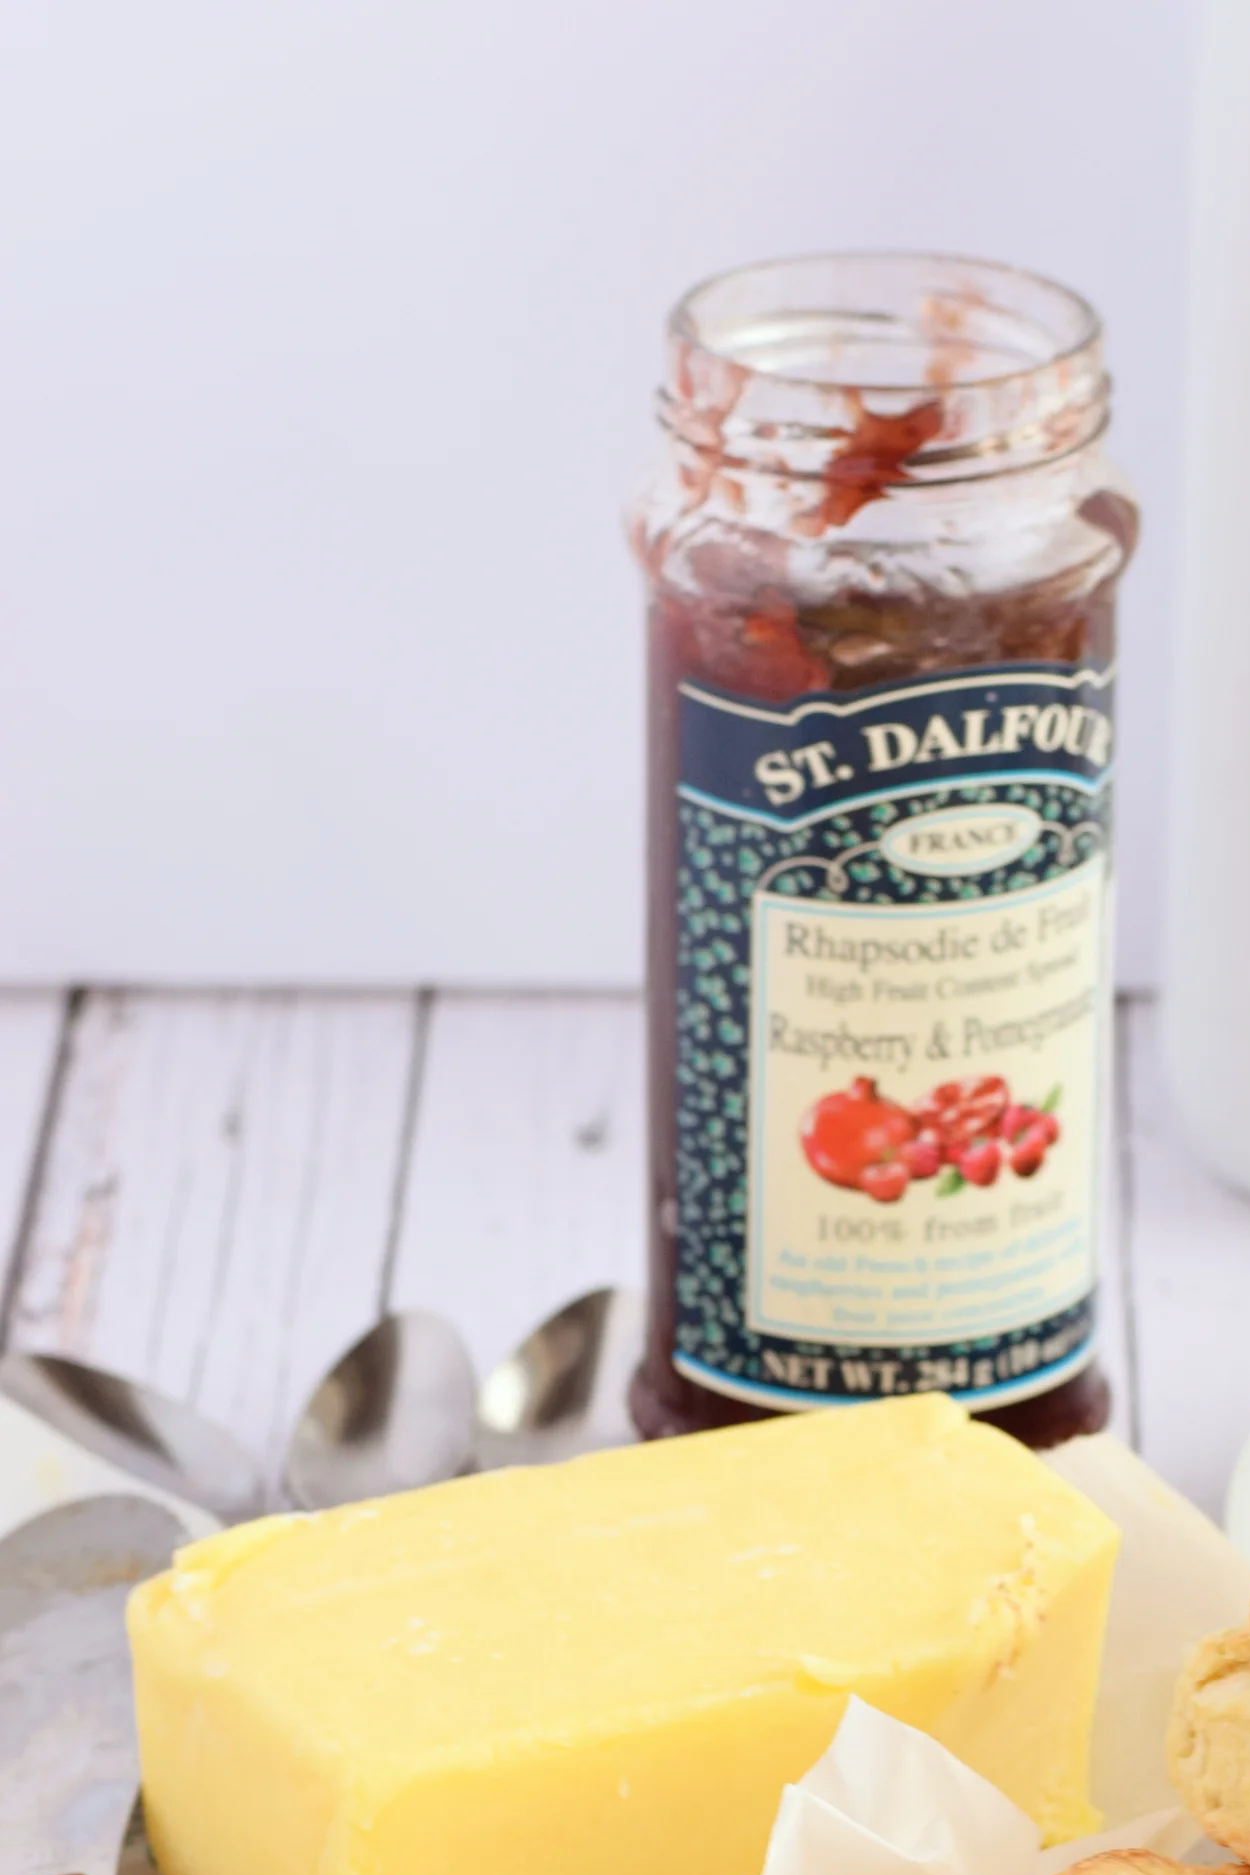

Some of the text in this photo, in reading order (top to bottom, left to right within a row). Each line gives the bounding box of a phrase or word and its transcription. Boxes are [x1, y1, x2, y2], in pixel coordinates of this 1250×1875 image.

[754, 741, 854, 806] ST.
[908, 822, 1019, 856] FRANCE
[784, 920, 980, 972] Rhapsodie
[990, 917, 1028, 954] de
[768, 1011, 916, 1073] Raspberry
[924, 1020, 952, 1061] &
[816, 1213, 909, 1244] 100%
[922, 1212, 999, 1244] from
[762, 1348, 833, 1391] NET
